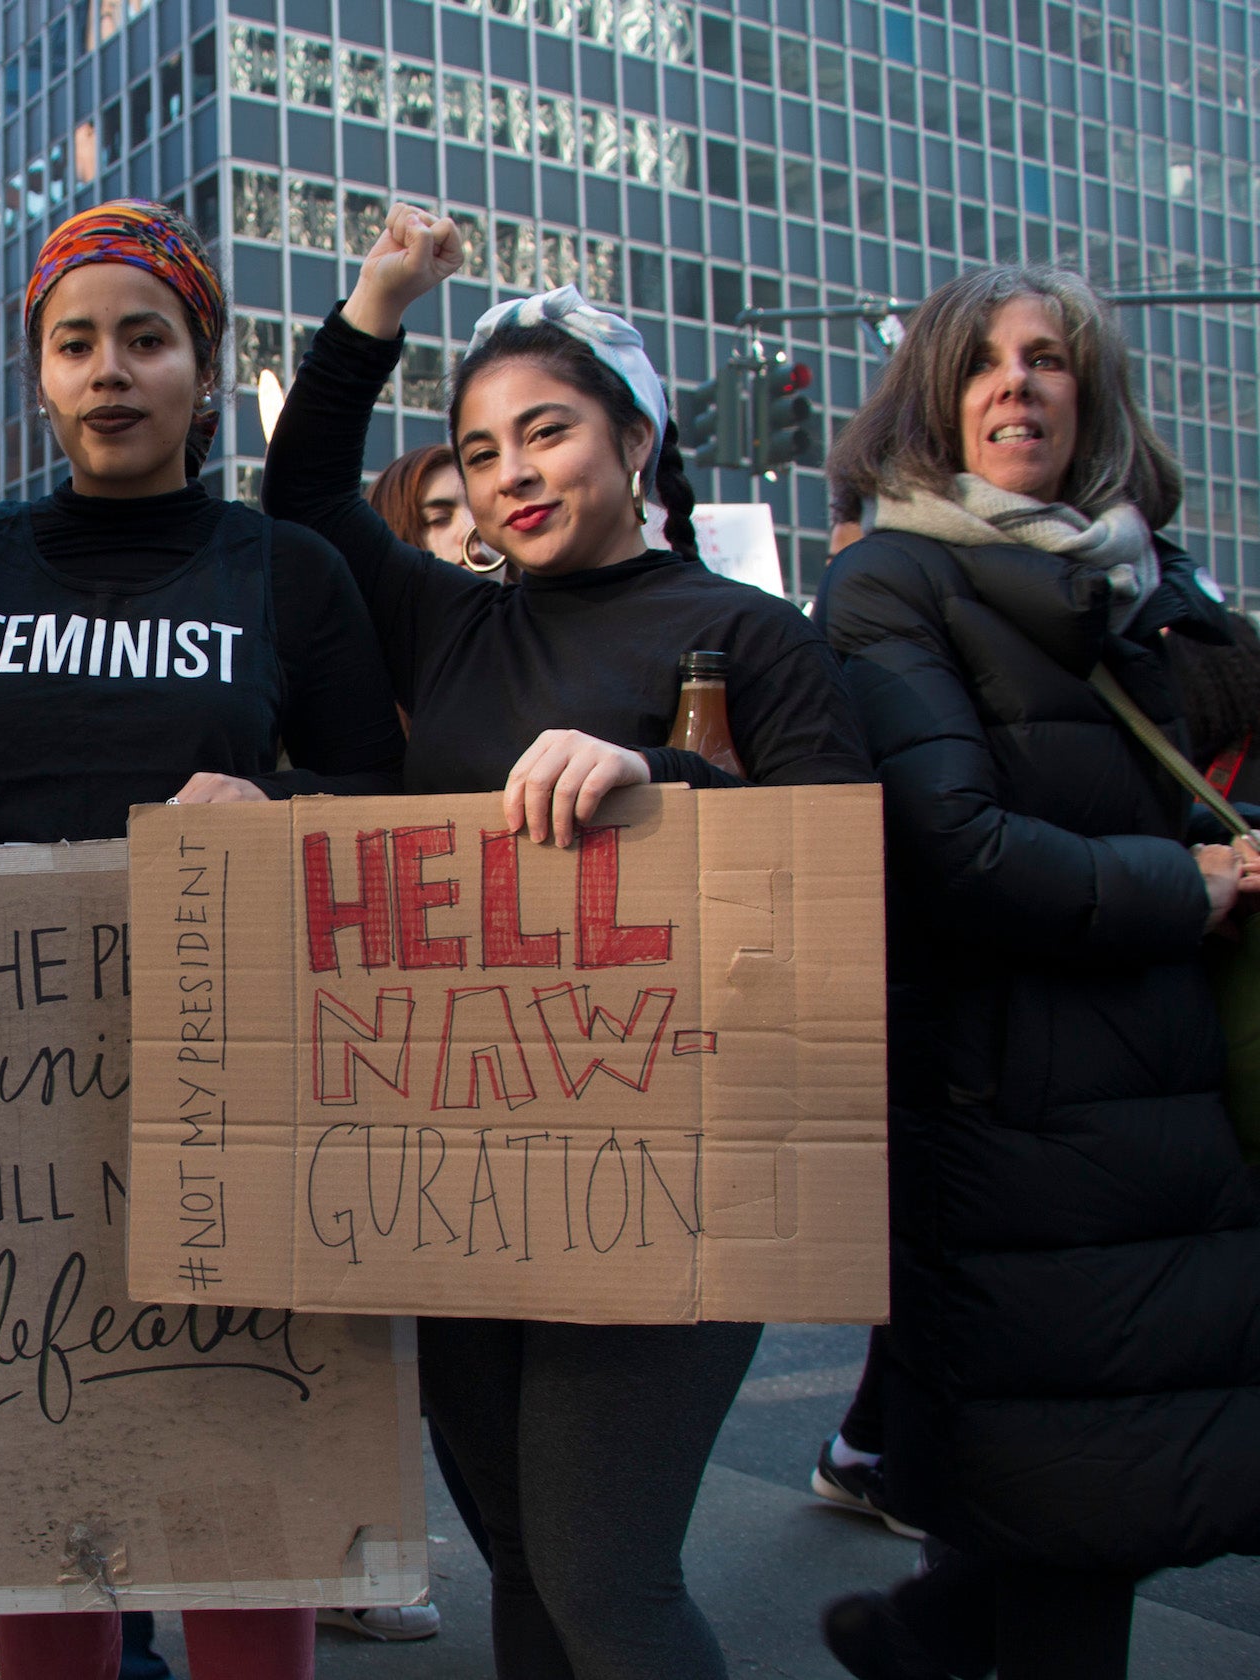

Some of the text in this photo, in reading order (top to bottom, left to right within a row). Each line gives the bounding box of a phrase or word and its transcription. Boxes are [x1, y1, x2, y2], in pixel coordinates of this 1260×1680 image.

[302, 820, 680, 977] HELL
[174, 835, 222, 1291] #NOT MY PRESIDENT
[312, 981, 718, 1111] NAW-
[308, 1122, 705, 1264] GURATION
